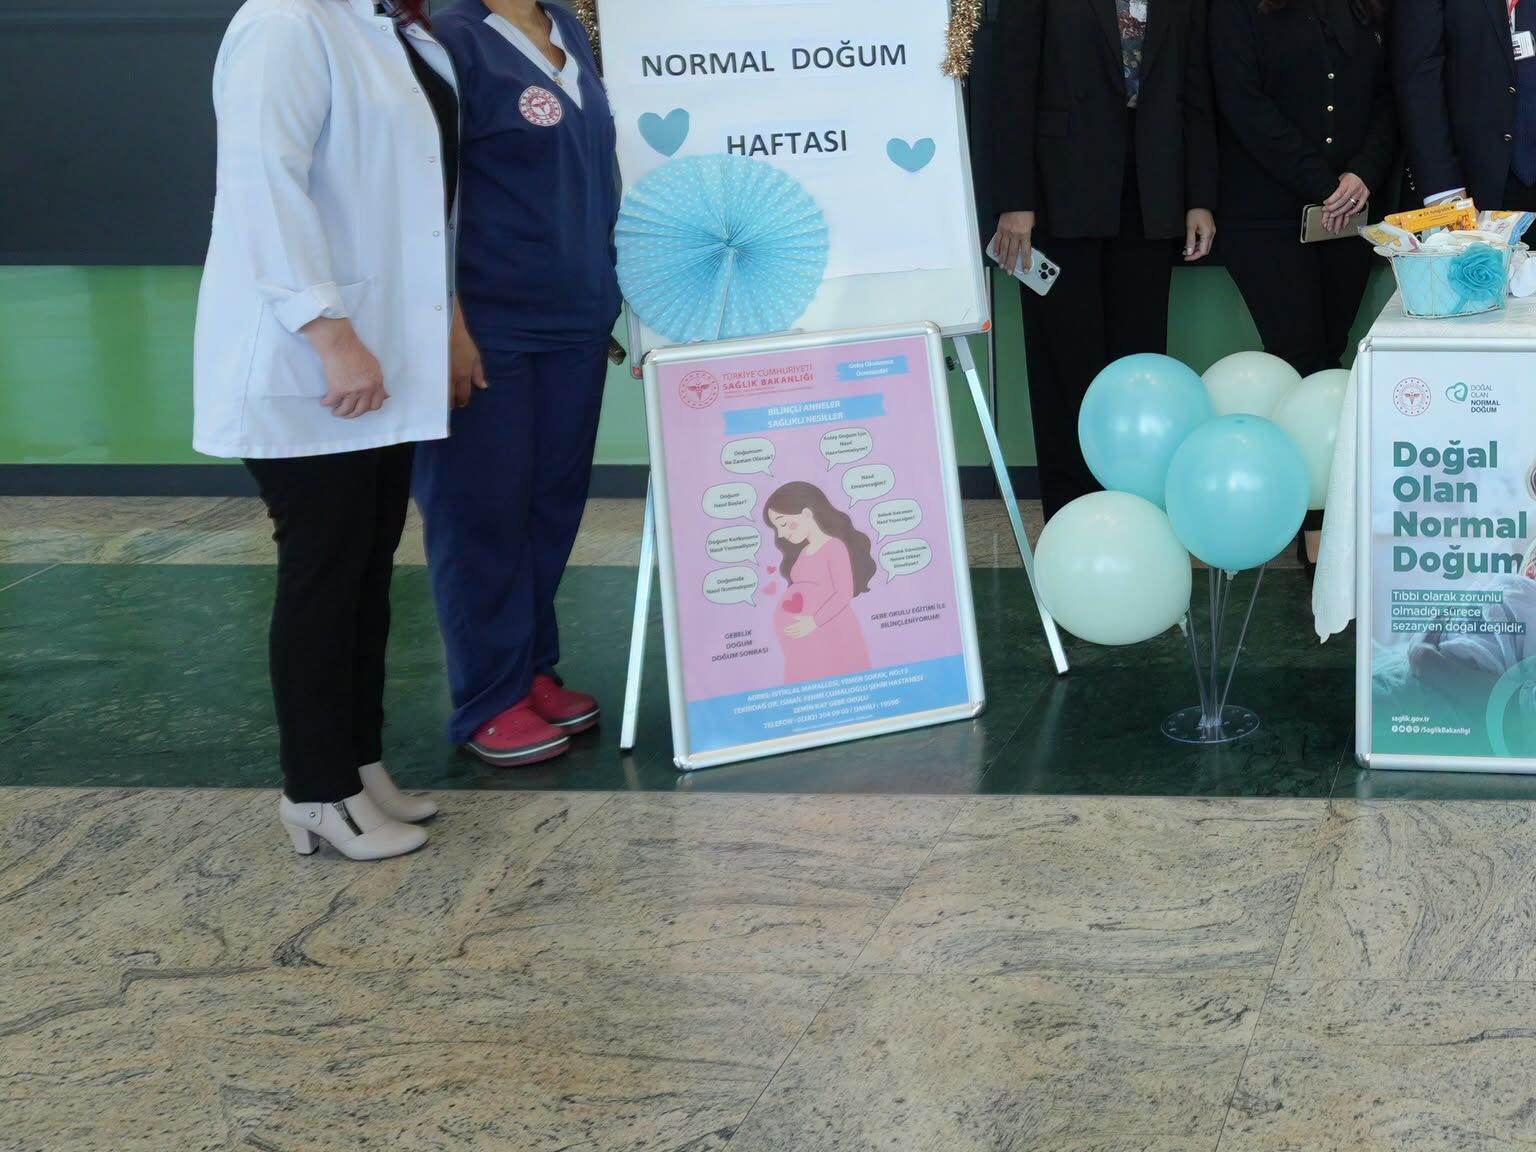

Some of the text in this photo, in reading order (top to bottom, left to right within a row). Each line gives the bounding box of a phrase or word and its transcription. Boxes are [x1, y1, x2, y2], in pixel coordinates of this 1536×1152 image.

[641, 40, 906, 77] NORMAL DOĞUM
[726, 129, 847, 157] HAFTASI
[1393, 440, 1498, 475] Doğal
[1393, 475, 1478, 503] Olan
[1393, 511, 1527, 538] Normal
[1393, 545, 1523, 580] Doğum
[1393, 591, 1501, 602] Tıbbi olarak zorunlu
[1393, 606, 1481, 618] olmadığı sürece
[1393, 622, 1524, 633] sezaryen doğal değildir.
